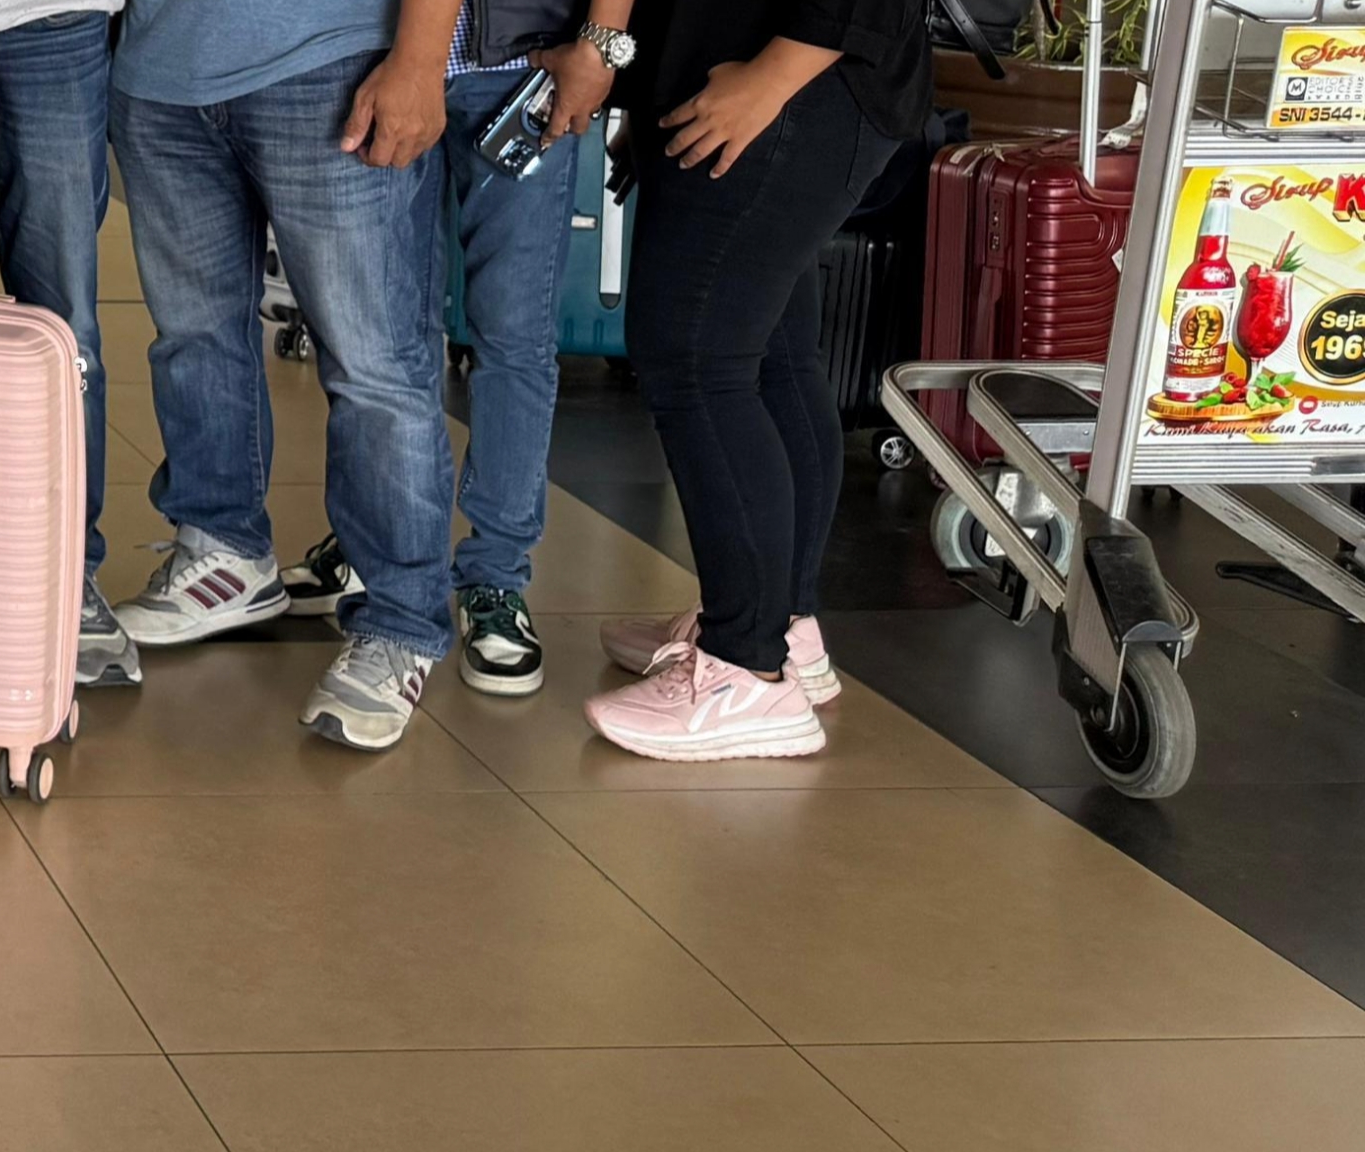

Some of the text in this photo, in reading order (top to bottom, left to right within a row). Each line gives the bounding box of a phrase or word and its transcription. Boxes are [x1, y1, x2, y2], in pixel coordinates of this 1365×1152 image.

[1279, 107, 1307, 122] SNI
[1240, 175, 1333, 209] Sirup
[1311, 334, 1365, 361] 196
[1255, 423, 1295, 434] akan
